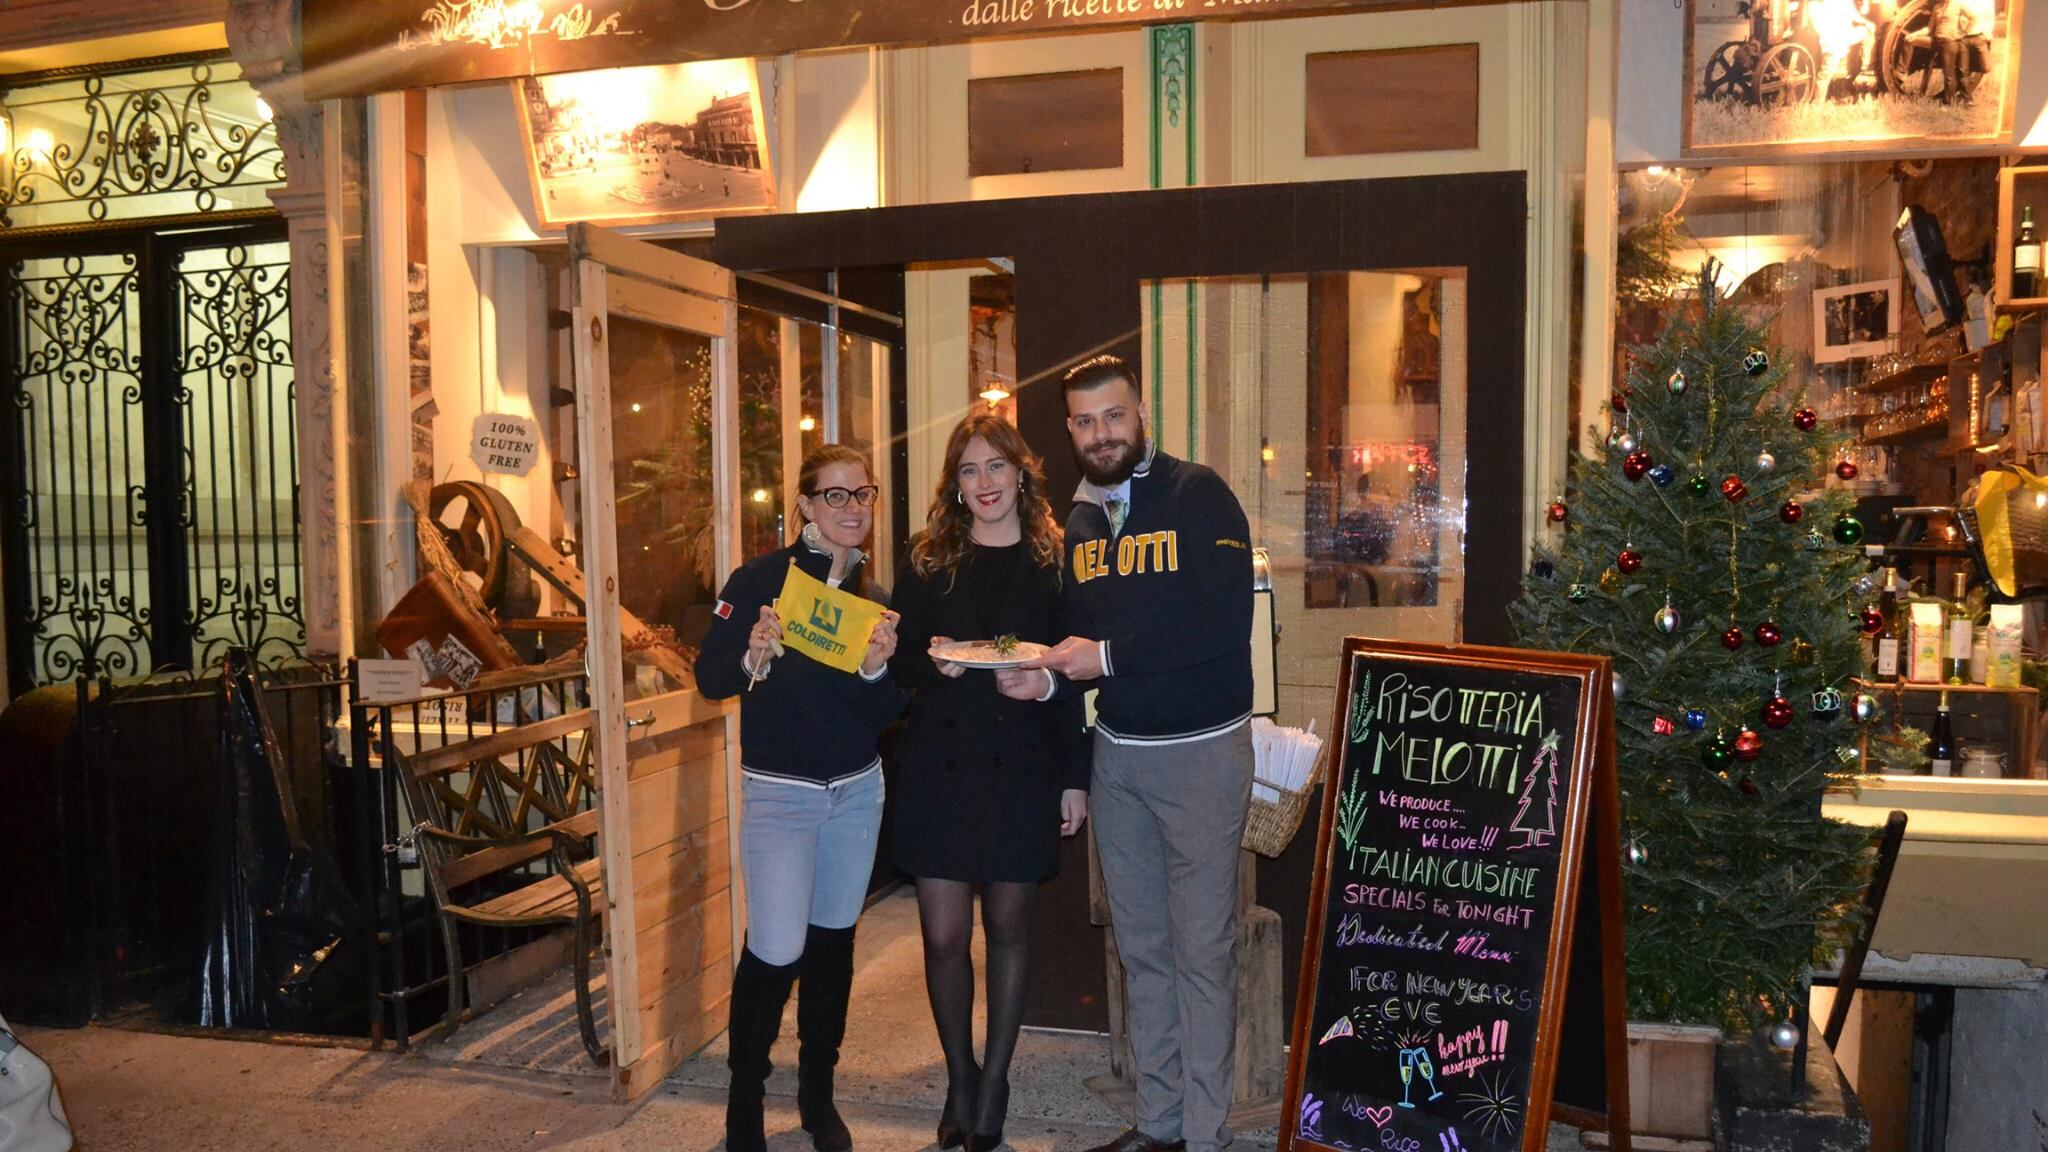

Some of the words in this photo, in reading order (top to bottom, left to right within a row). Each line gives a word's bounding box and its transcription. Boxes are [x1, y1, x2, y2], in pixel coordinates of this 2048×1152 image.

[962, 0, 1033, 26] dalle
[491, 422, 526, 436] 100%
[480, 436, 533, 453] GLUTEN
[488, 454, 521, 468] FREE
[787, 620, 847, 656] COLDIRETTI
[1379, 789, 1397, 808] WE
[1400, 814, 1420, 829] WE
[1422, 833, 1439, 848] WE
[1343, 883, 1426, 910] SPECIALS
[1456, 900, 1535, 928] TONIGHT
[1336, 912, 1449, 951] Dedicated
[1406, 971, 1455, 997] NEW
[1379, 996, 1442, 1026] EVE
[1437, 1025, 1486, 1059] happy
[1341, 1094, 1368, 1120] We
